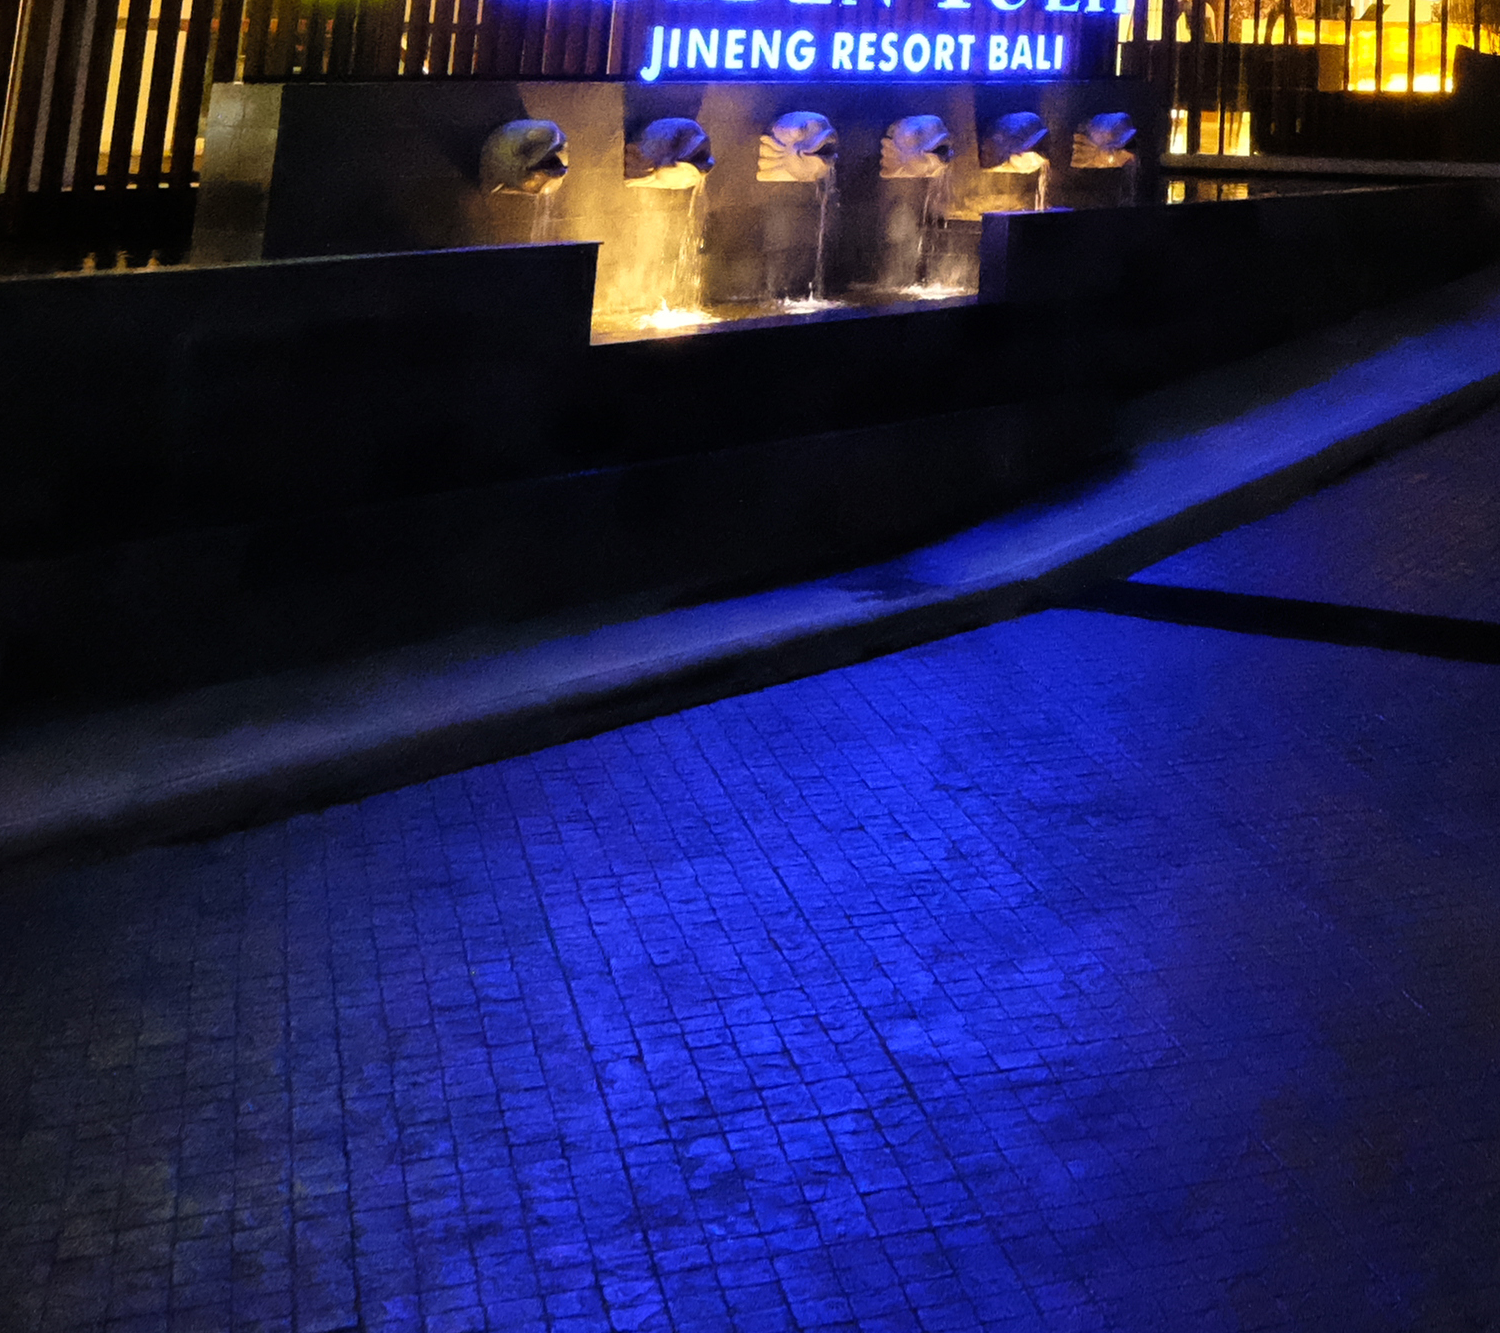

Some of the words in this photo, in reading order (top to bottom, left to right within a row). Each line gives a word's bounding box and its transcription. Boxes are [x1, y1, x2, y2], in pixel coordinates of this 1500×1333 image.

[640, 25, 817, 82] JINENG
[831, 32, 976, 73] RESORT
[989, 34, 1064, 71] BALI
